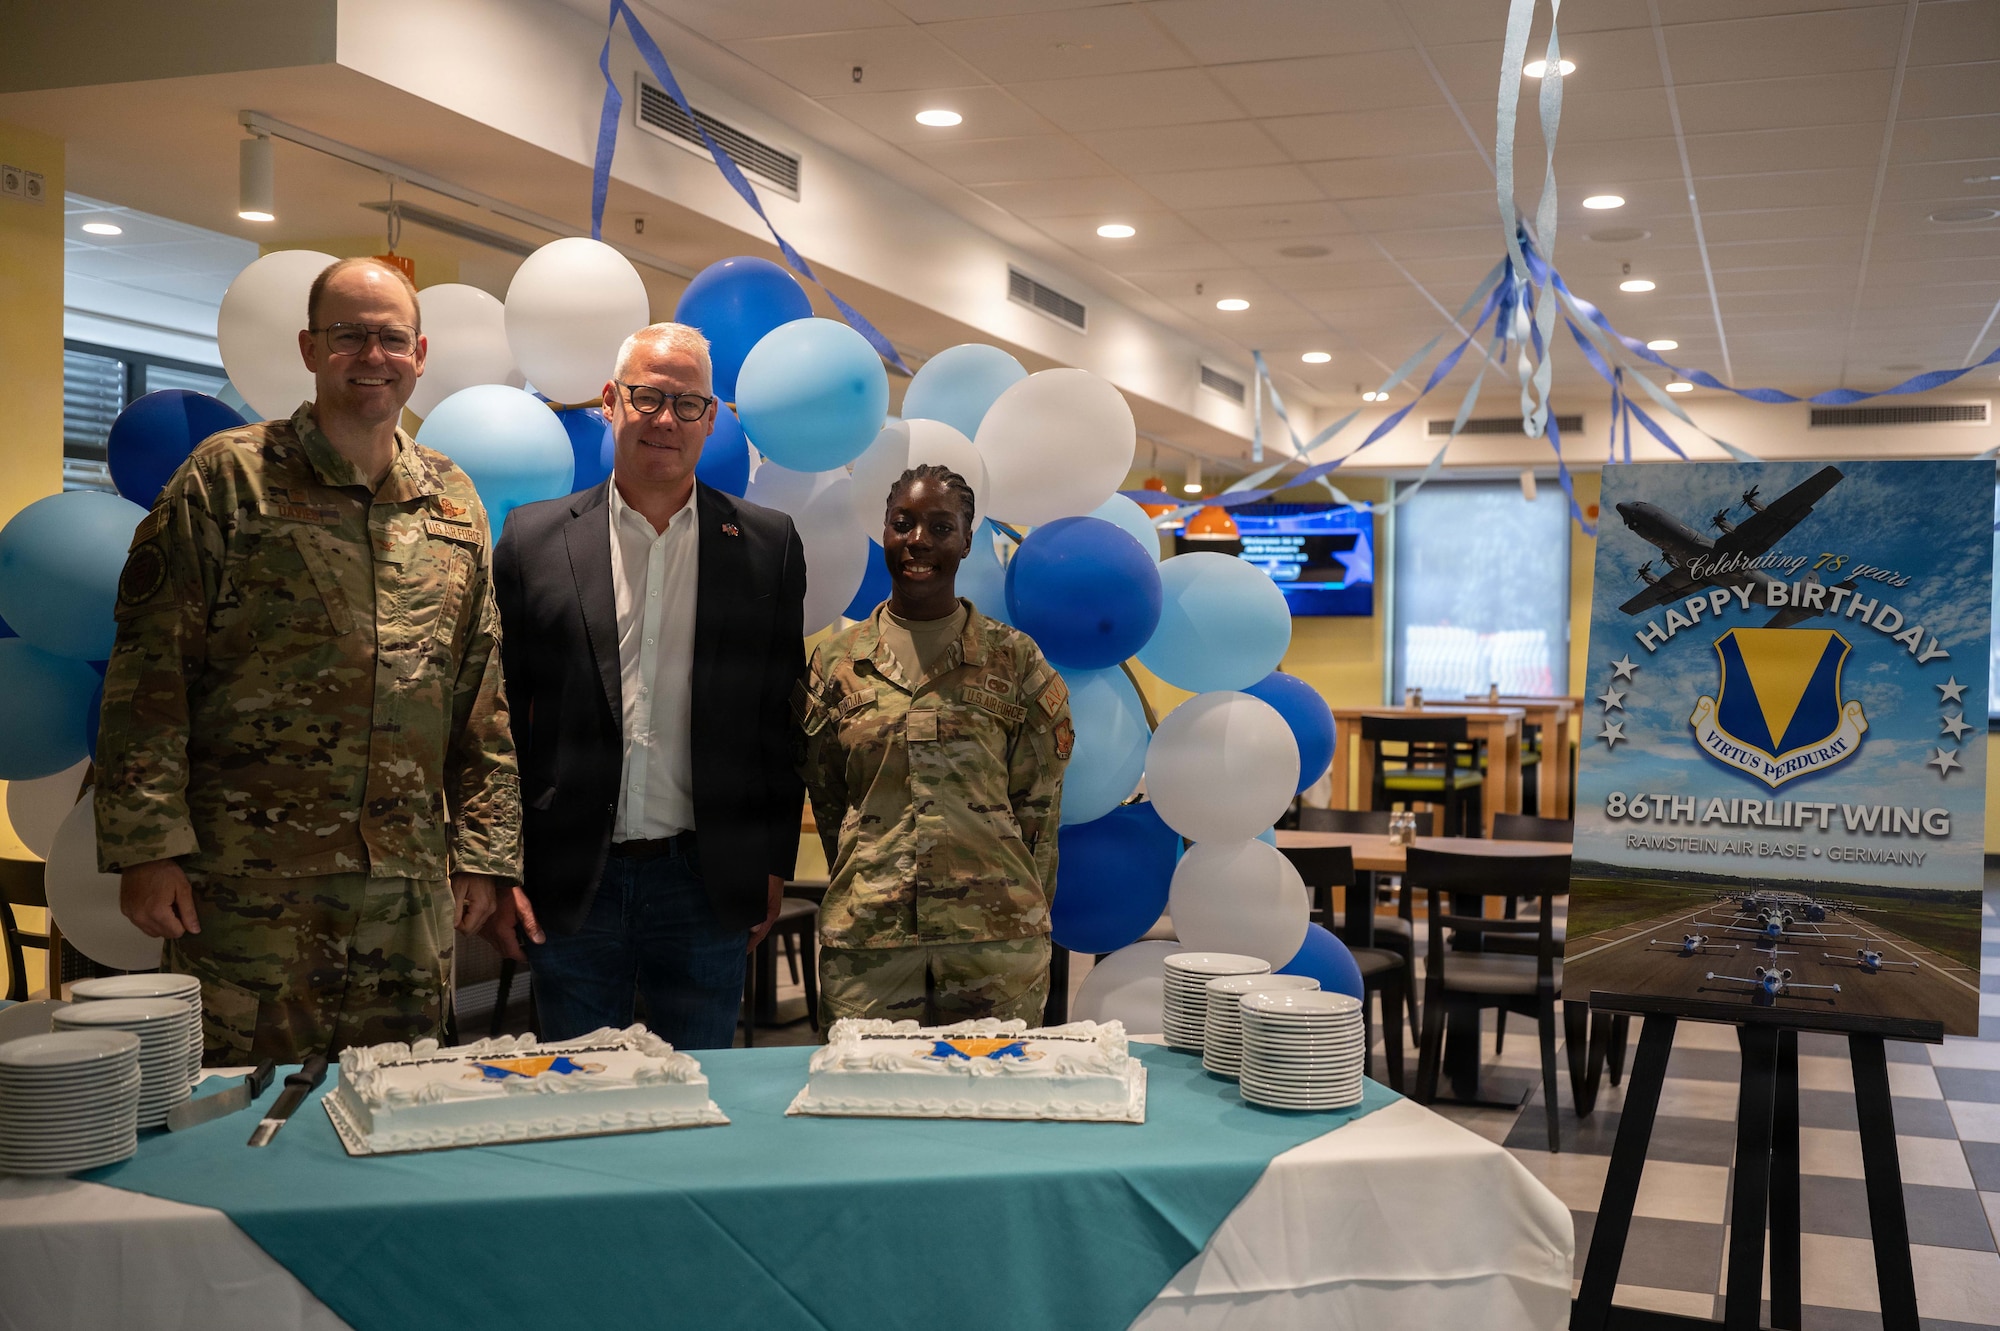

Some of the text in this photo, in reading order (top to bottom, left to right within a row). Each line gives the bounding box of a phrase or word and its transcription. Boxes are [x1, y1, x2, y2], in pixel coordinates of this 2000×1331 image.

[444, 525, 457, 538] AIR
[457, 528, 481, 543] FORCE
[1686, 550, 1909, 588] Celebrating 78 years
[1635, 581, 1951, 664] HAPPY BIRTHDAY
[967, 689, 1024, 719] U.S. AIR FORCE
[1706, 730, 1848, 780] VIRTUS PERDURAT
[1606, 791, 1950, 836] 86TH AIRLIFT WING
[1627, 833, 1927, 865] RAMSTEIN AIR BASE GERMANY
